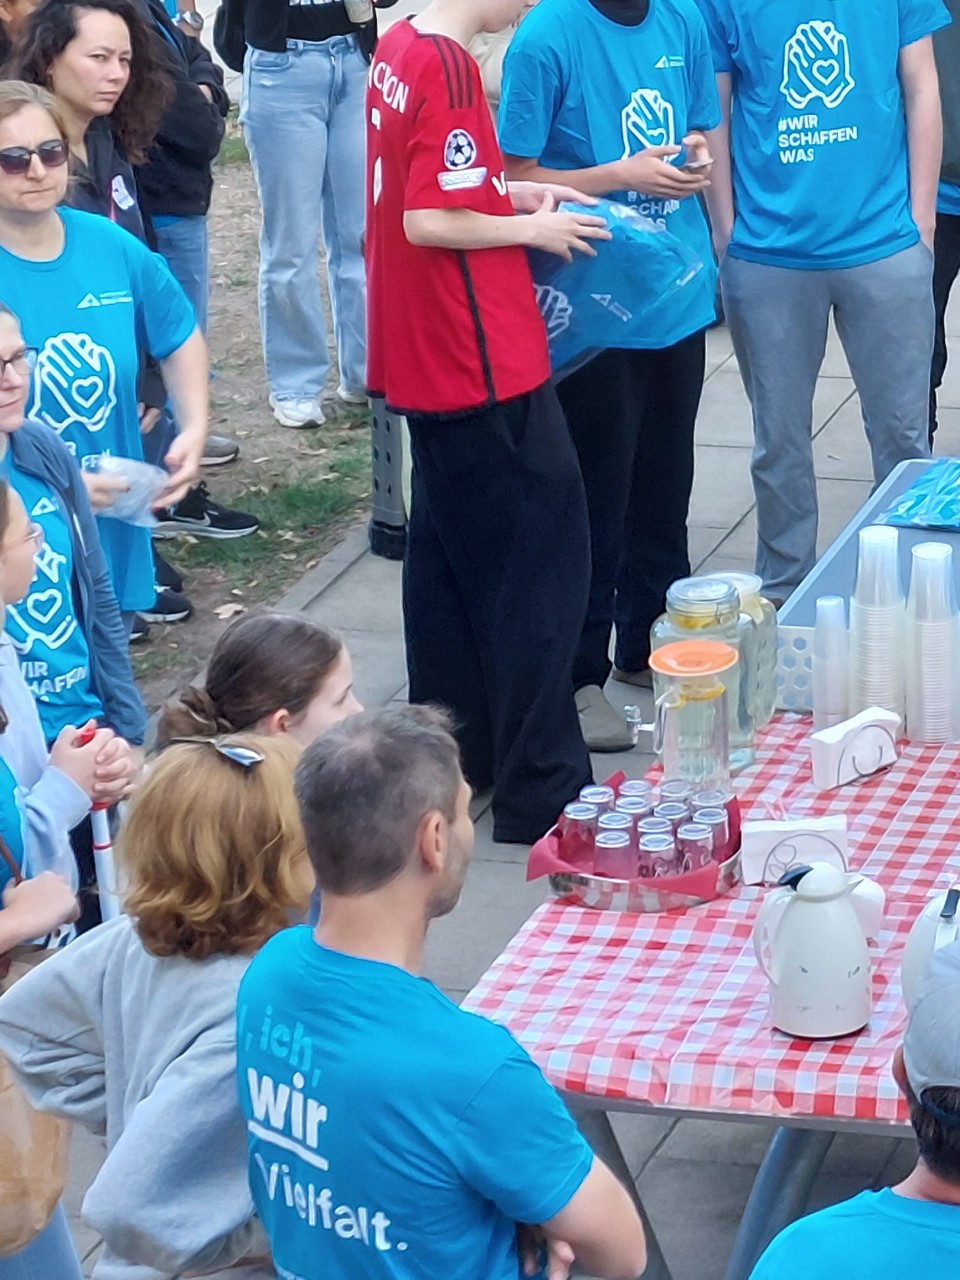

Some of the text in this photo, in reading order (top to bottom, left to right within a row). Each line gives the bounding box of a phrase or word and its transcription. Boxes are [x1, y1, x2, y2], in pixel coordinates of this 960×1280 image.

[777, 114, 818, 132] #WIR
[778, 126, 858, 148] SCHAFFEN
[779, 148, 815, 164] WAS
[247, 1067, 328, 1149] wir
[254, 1152, 409, 1251] Vielfalt.
